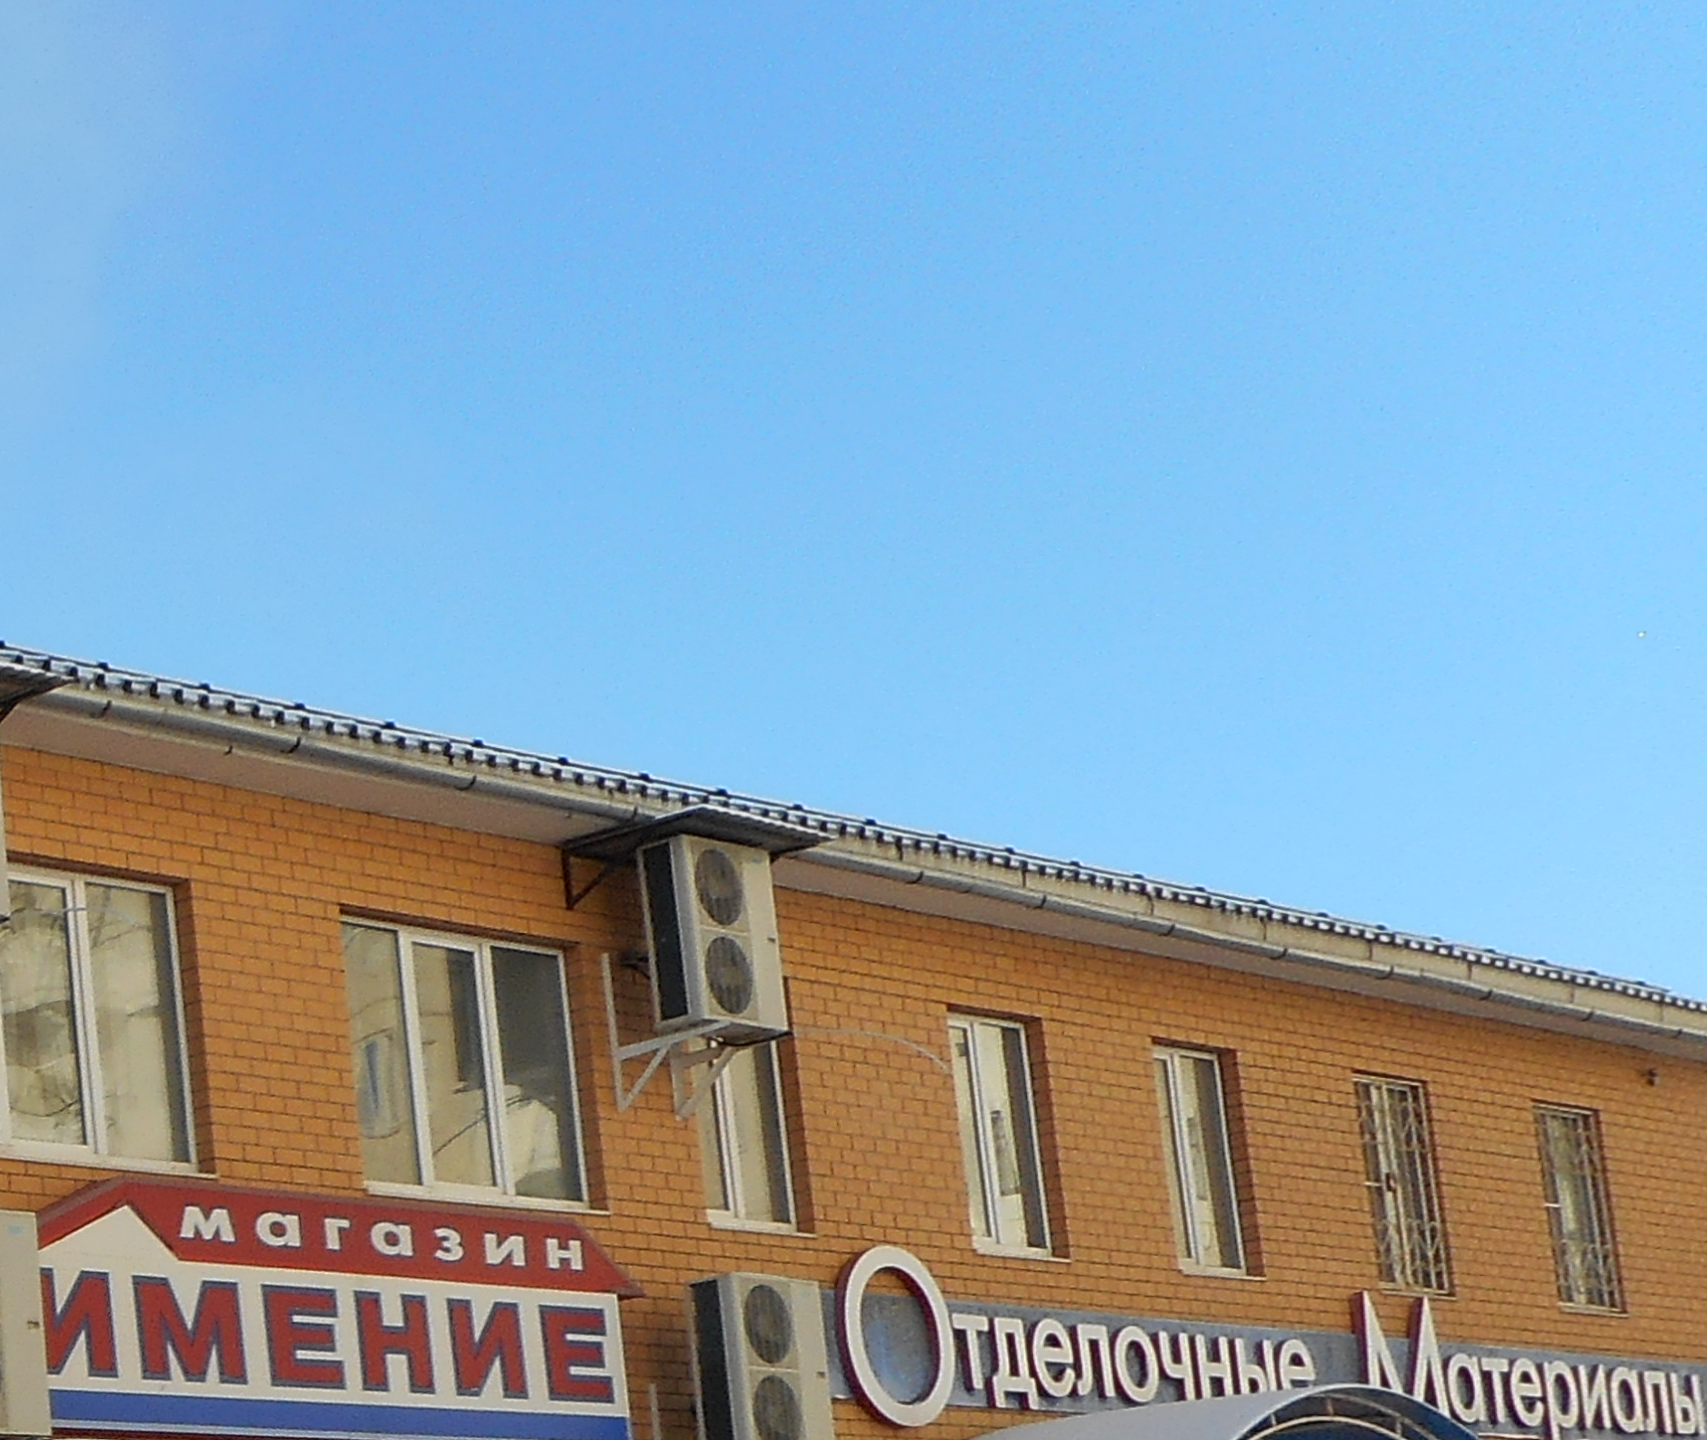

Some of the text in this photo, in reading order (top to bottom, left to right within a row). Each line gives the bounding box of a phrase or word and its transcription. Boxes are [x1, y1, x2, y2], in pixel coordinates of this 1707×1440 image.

[179, 1204, 584, 1272] магазин
[40, 1265, 615, 1403] ИМЕНИЕ
[836, 1245, 1317, 1427] Отделочные
